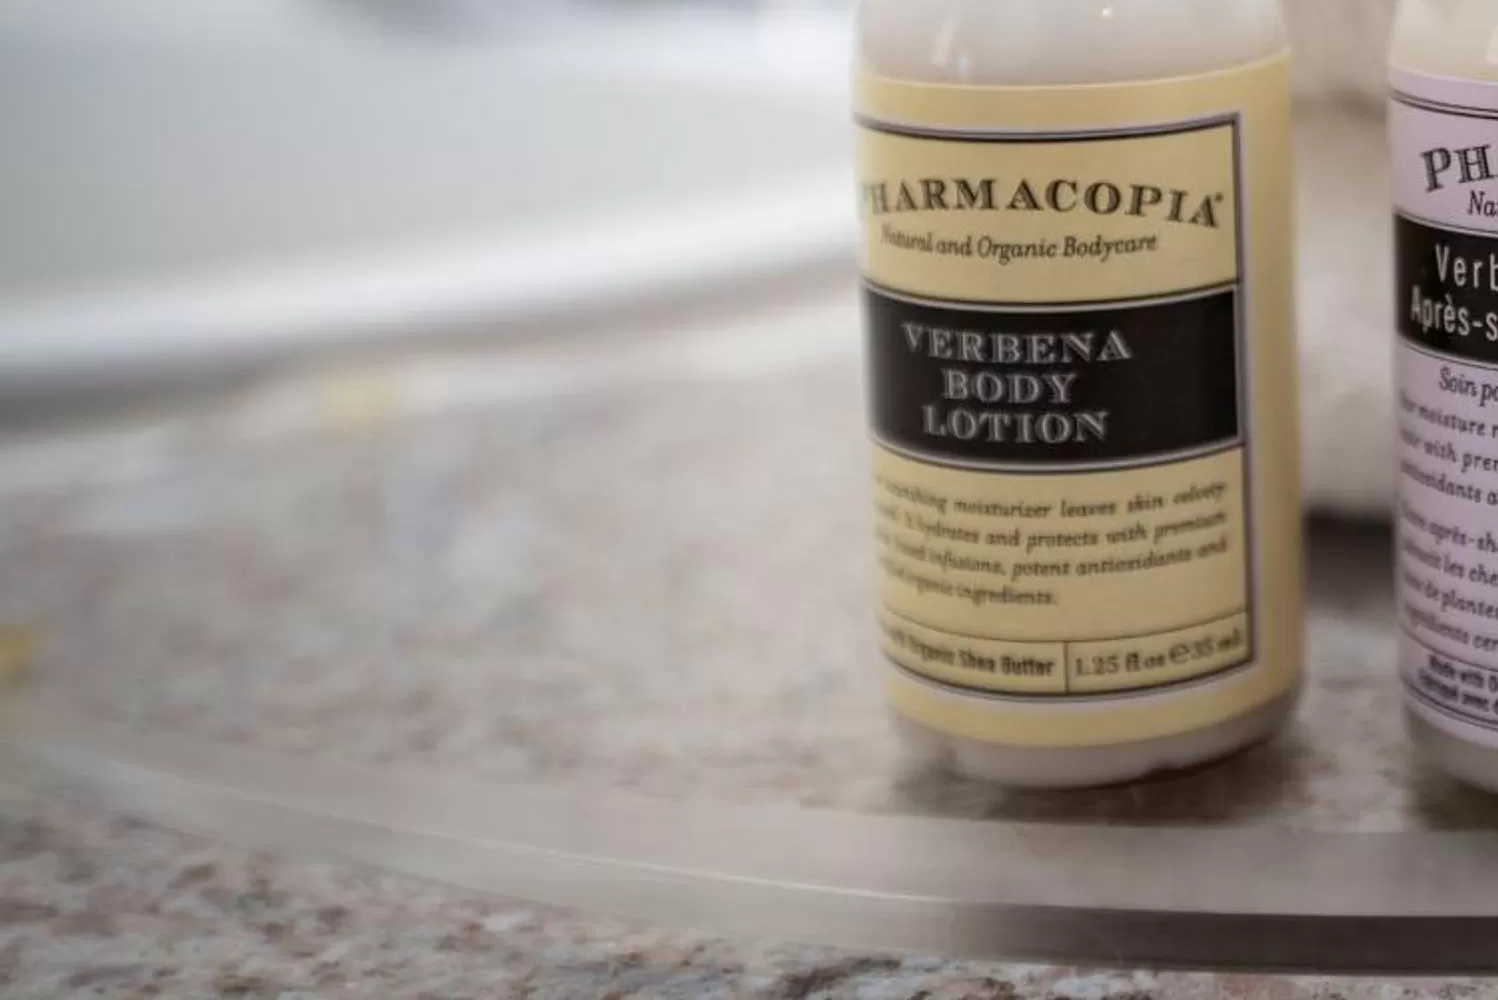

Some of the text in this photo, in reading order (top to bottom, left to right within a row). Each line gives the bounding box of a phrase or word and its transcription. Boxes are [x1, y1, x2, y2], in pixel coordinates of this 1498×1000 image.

[936, 235, 972, 256] and
[977, 234, 1058, 266] Organic
[1063, 234, 1158, 263] Bodycare
[902, 322, 1132, 365] VERBENA
[941, 368, 1078, 404] BODY
[1438, 366, 1478, 398] Soin
[922, 404, 1110, 444] LOTION
[1060, 498, 1117, 518] leaves
[1127, 493, 1164, 514] skin
[985, 527, 1020, 547] and
[1026, 530, 1099, 556] protects
[1106, 520, 1148, 545] with
[1011, 559, 1070, 583] potent
[958, 648, 997, 674] Shea
[1001, 654, 1055, 677] Butter
